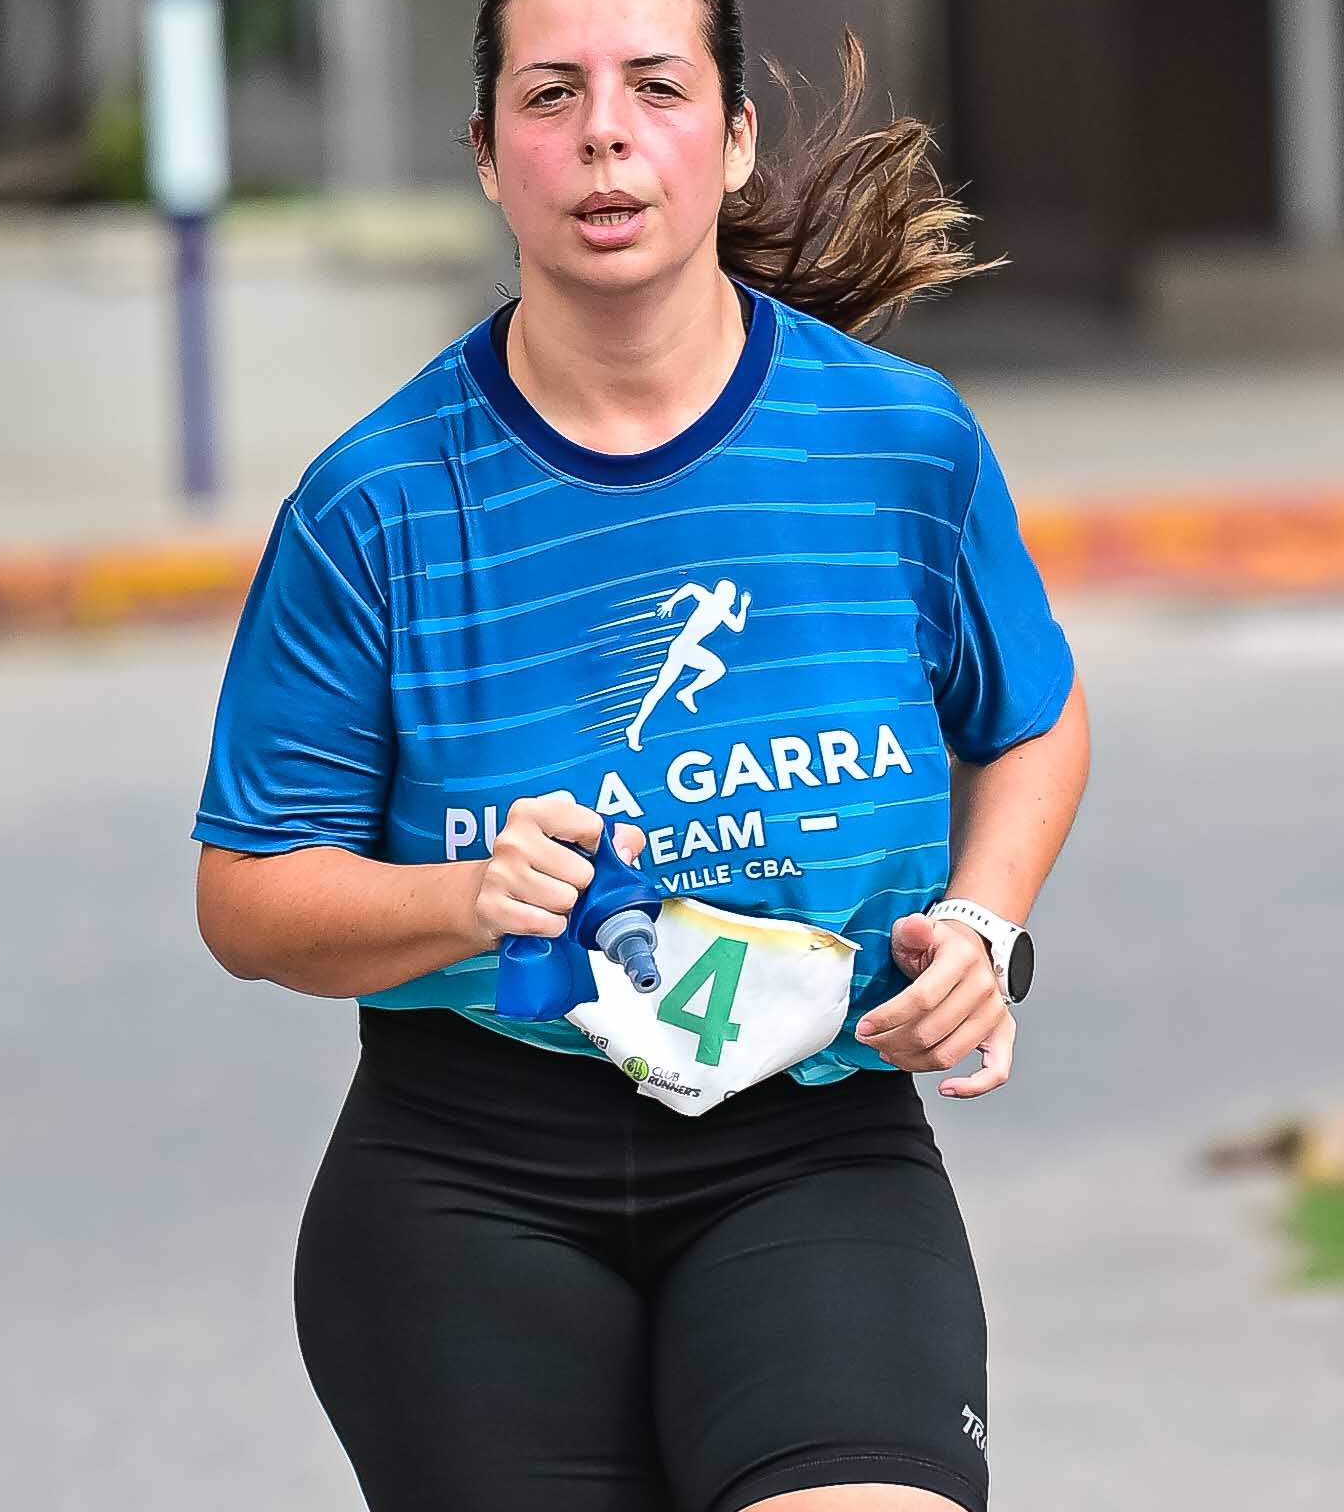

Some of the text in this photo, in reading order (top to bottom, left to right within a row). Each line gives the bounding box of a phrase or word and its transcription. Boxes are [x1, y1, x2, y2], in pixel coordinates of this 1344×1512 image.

[446, 724, 913, 862] PA GARRA
[630, 810, 766, 870] EAM
[661, 864, 732, 894] VILLE
[656, 936, 749, 1066] 4
[652, 1066, 681, 1082] CLUB
